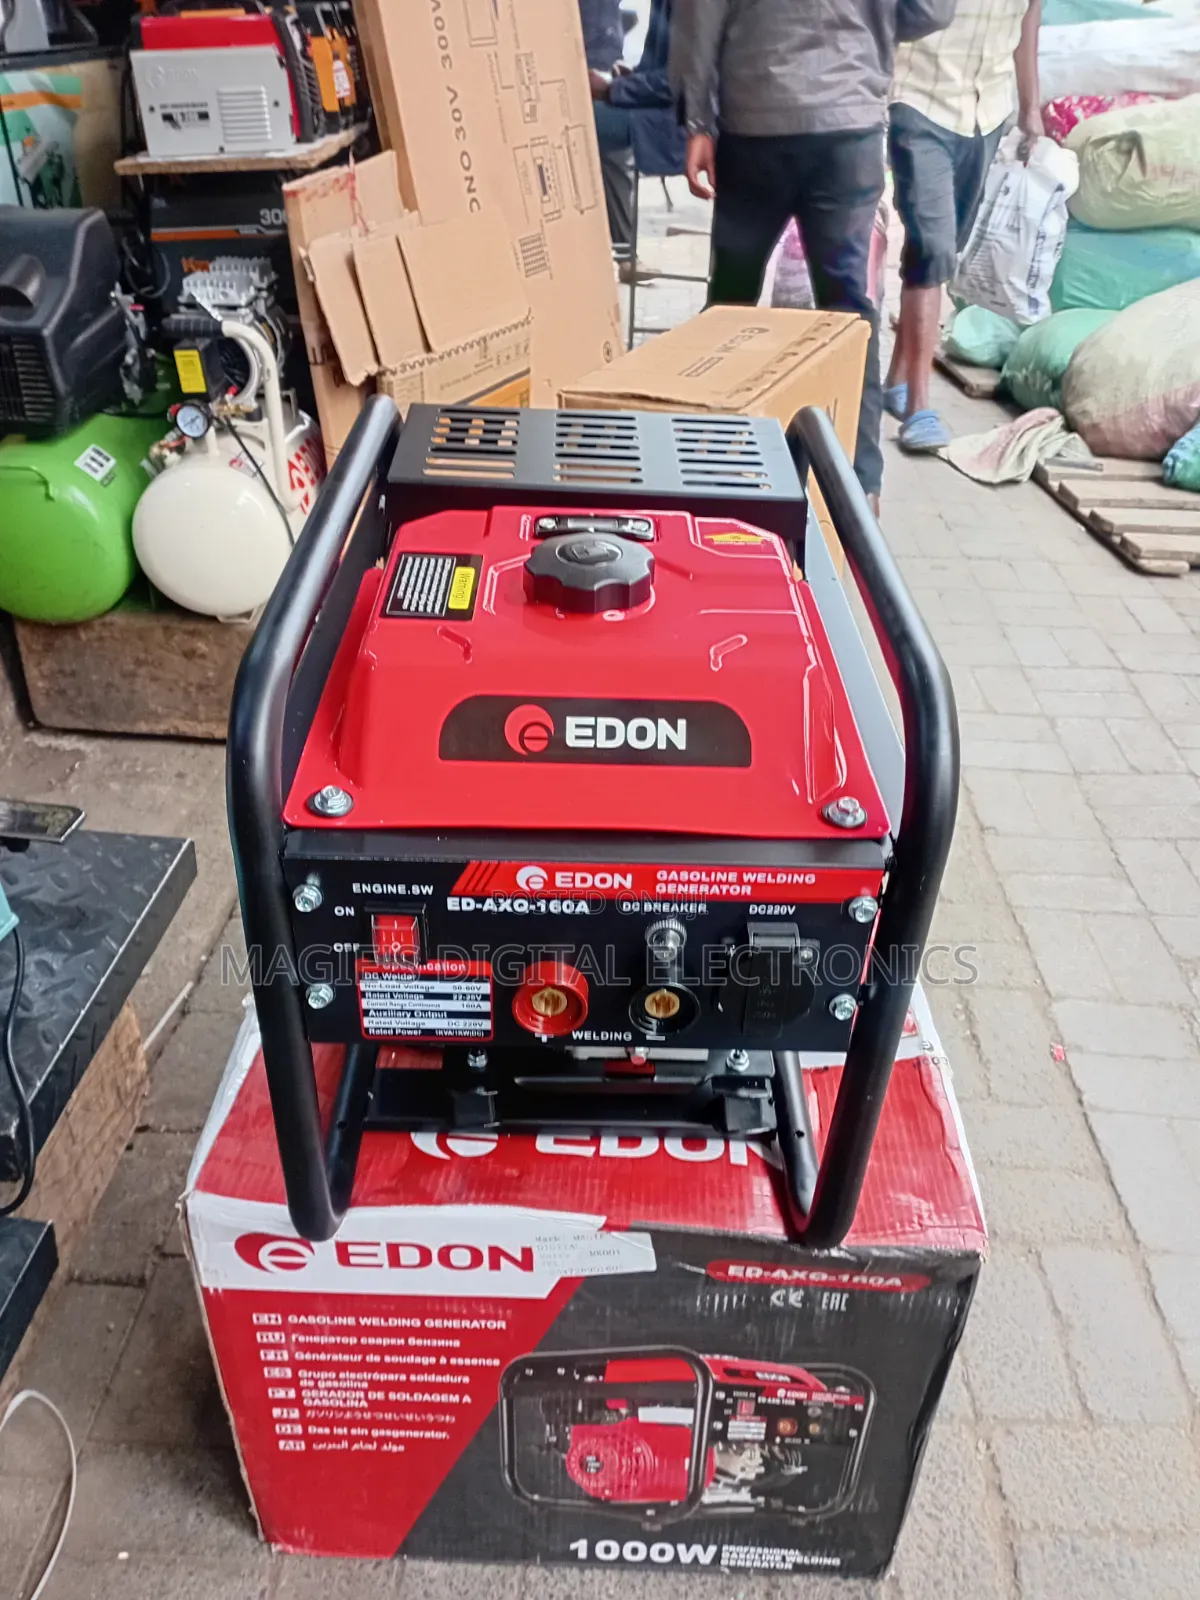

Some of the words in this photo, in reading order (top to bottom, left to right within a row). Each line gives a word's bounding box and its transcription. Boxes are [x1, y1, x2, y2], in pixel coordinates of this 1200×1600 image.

[446, 86, 467, 141] 30V
[566, 716, 687, 750] EDON
[555, 872, 632, 889] EDON
[656, 870, 737, 883] GASOLINE
[742, 872, 816, 884] WELDING
[655, 882, 752, 895] GENERATOR
[334, 905, 355, 917] ON
[643, 902, 708, 913] BREAKER
[333, 942, 361, 953] OFF
[404, 983, 436, 993] Voltage
[365, 992, 391, 1000] Rated
[393, 992, 425, 1001] Voltage
[368, 1010, 412, 1019] Auxiliary
[414, 1010, 448, 1020] Output
[394, 1020, 426, 1029] Voltage
[368, 1028, 394, 1036] Rated
[395, 1028, 422, 1036] Power
[571, 1030, 632, 1042] WELDING
[334, 1240, 535, 1273] EDON
[288, 1314, 356, 1327] GASOLINE
[359, 1316, 422, 1328] WELDING
[424, 1317, 507, 1330] GENERATOR
[365, 1352, 381, 1363] de
[298, 1368, 337, 1381] Grupo
[299, 1379, 315, 1388] de
[317, 1379, 369, 1390] gasolina
[301, 1389, 365, 1400] GERADOR
[367, 1391, 386, 1401] DE
[388, 1391, 460, 1404] SOLDAGEM
[462, 1394, 472, 1405] A
[303, 1398, 368, 1409] GASOLINA
[307, 1424, 331, 1435] Das
[333, 1425, 348, 1435] ist
[350, 1426, 369, 1436] ein
[569, 1537, 718, 1566] 1000W
